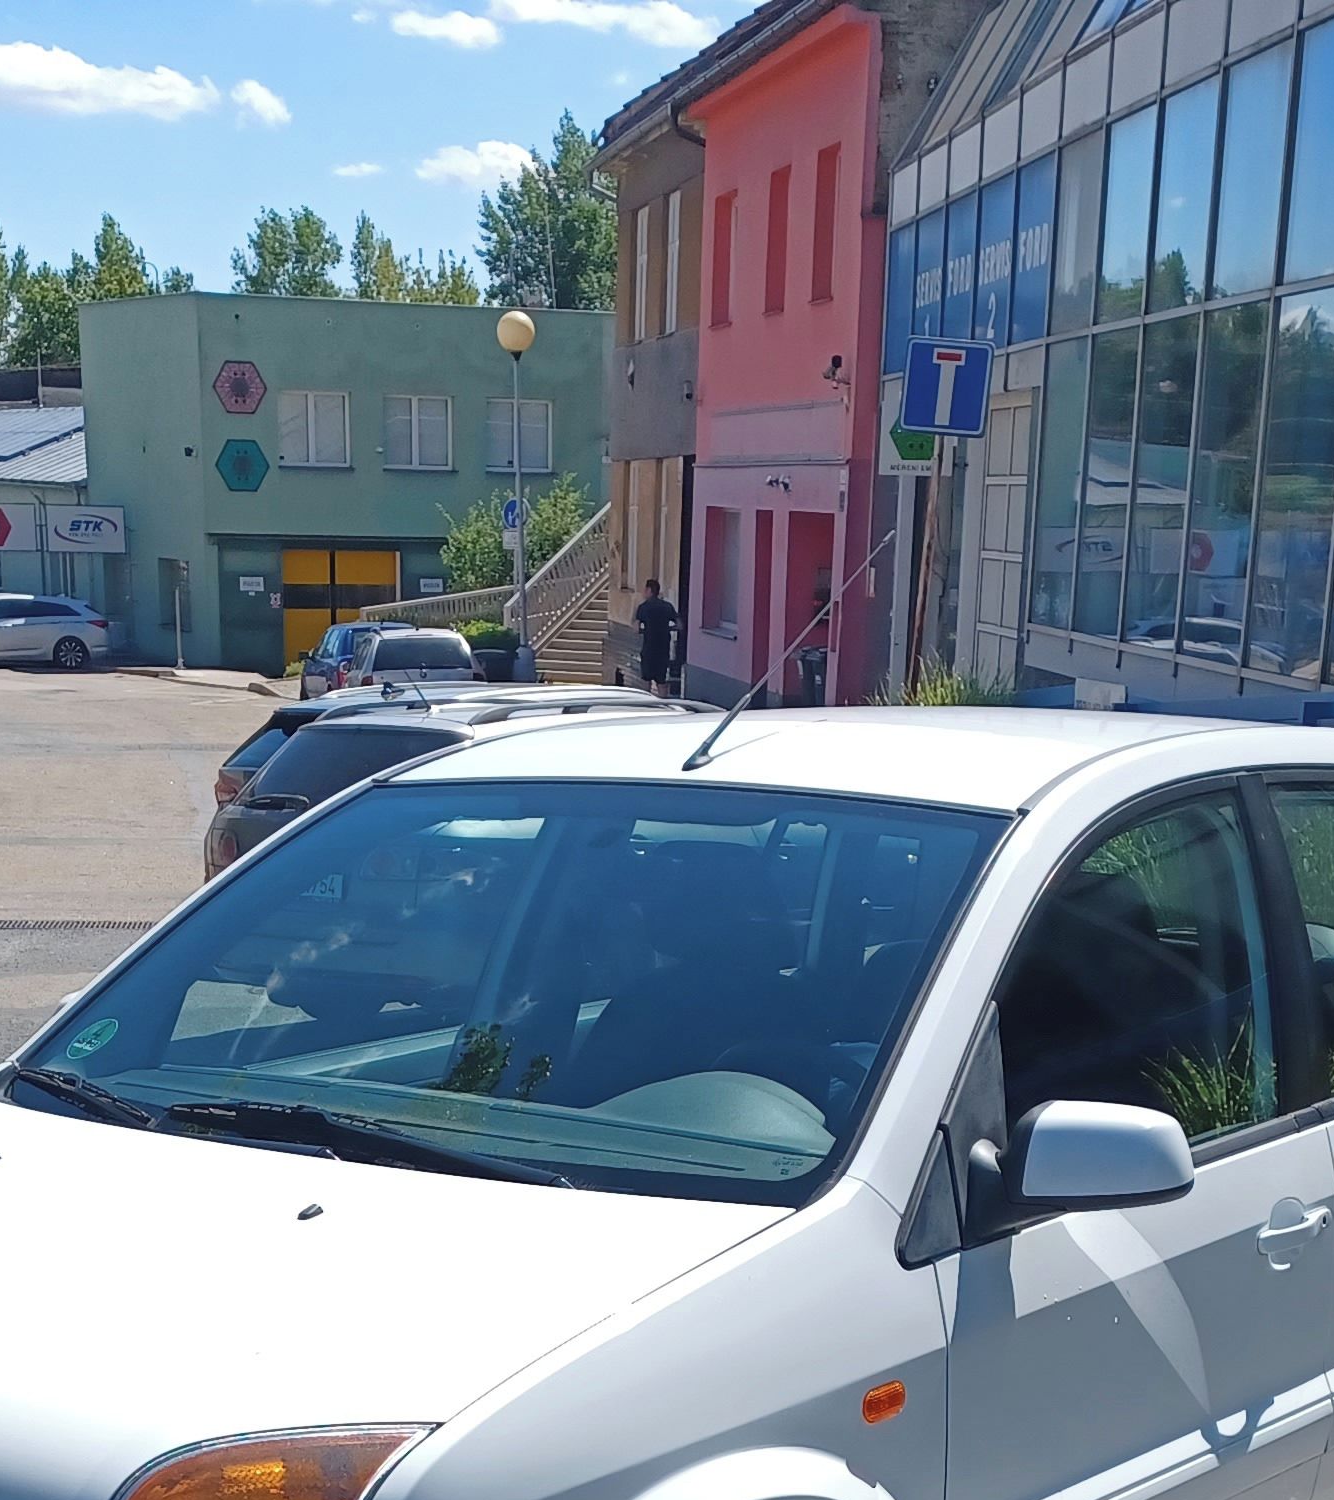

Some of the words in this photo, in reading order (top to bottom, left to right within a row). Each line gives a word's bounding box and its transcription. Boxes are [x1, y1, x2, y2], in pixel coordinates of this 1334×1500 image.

[947, 254, 972, 298] FORD
[1019, 223, 1049, 273] FORD
[986, 292, 996, 339] 2
[69, 520, 104, 532] STK
